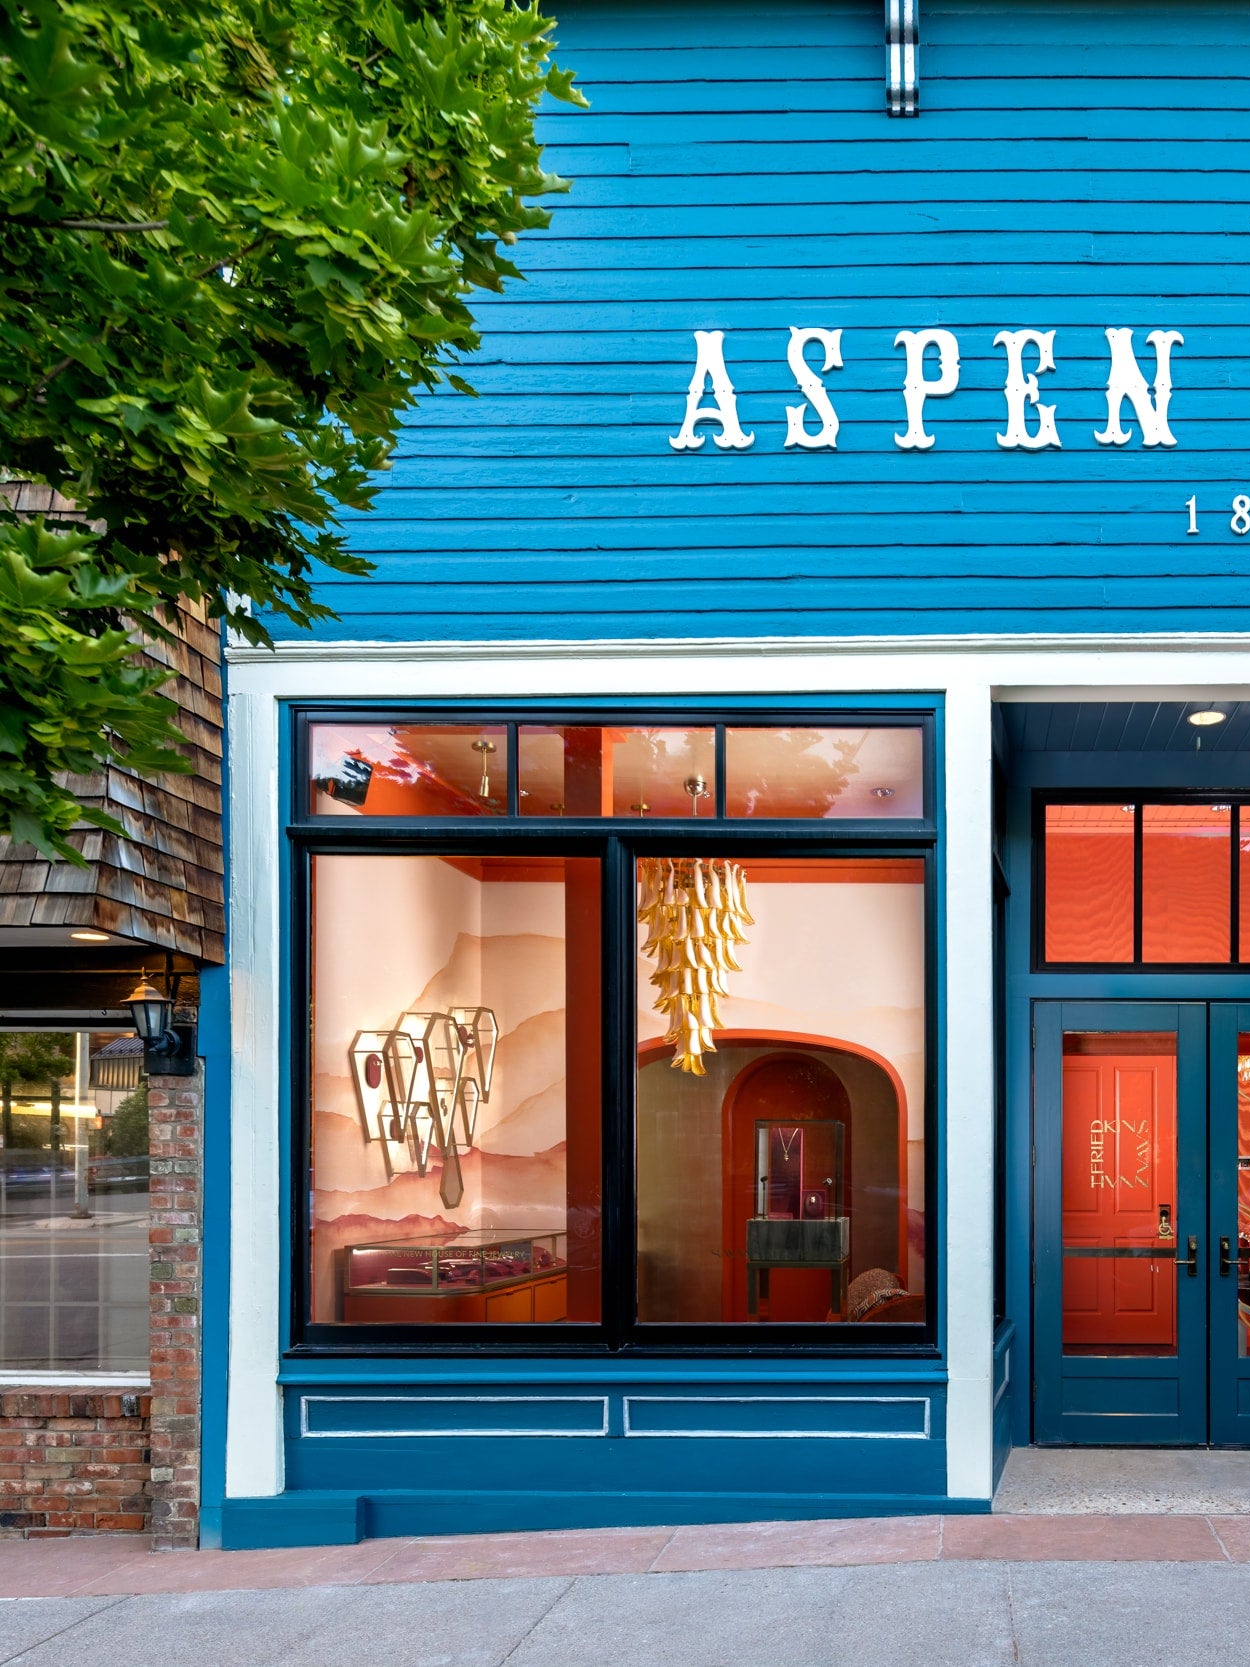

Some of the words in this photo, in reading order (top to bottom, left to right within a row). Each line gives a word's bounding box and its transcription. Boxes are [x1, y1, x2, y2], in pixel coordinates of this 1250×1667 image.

[669, 326, 1184, 451] ASPEN
[404, 1250, 424, 1258] NEW
[425, 1250, 453, 1258] HOUSE
[455, 1250, 466, 1258] OF
[468, 1250, 487, 1258] FINE
